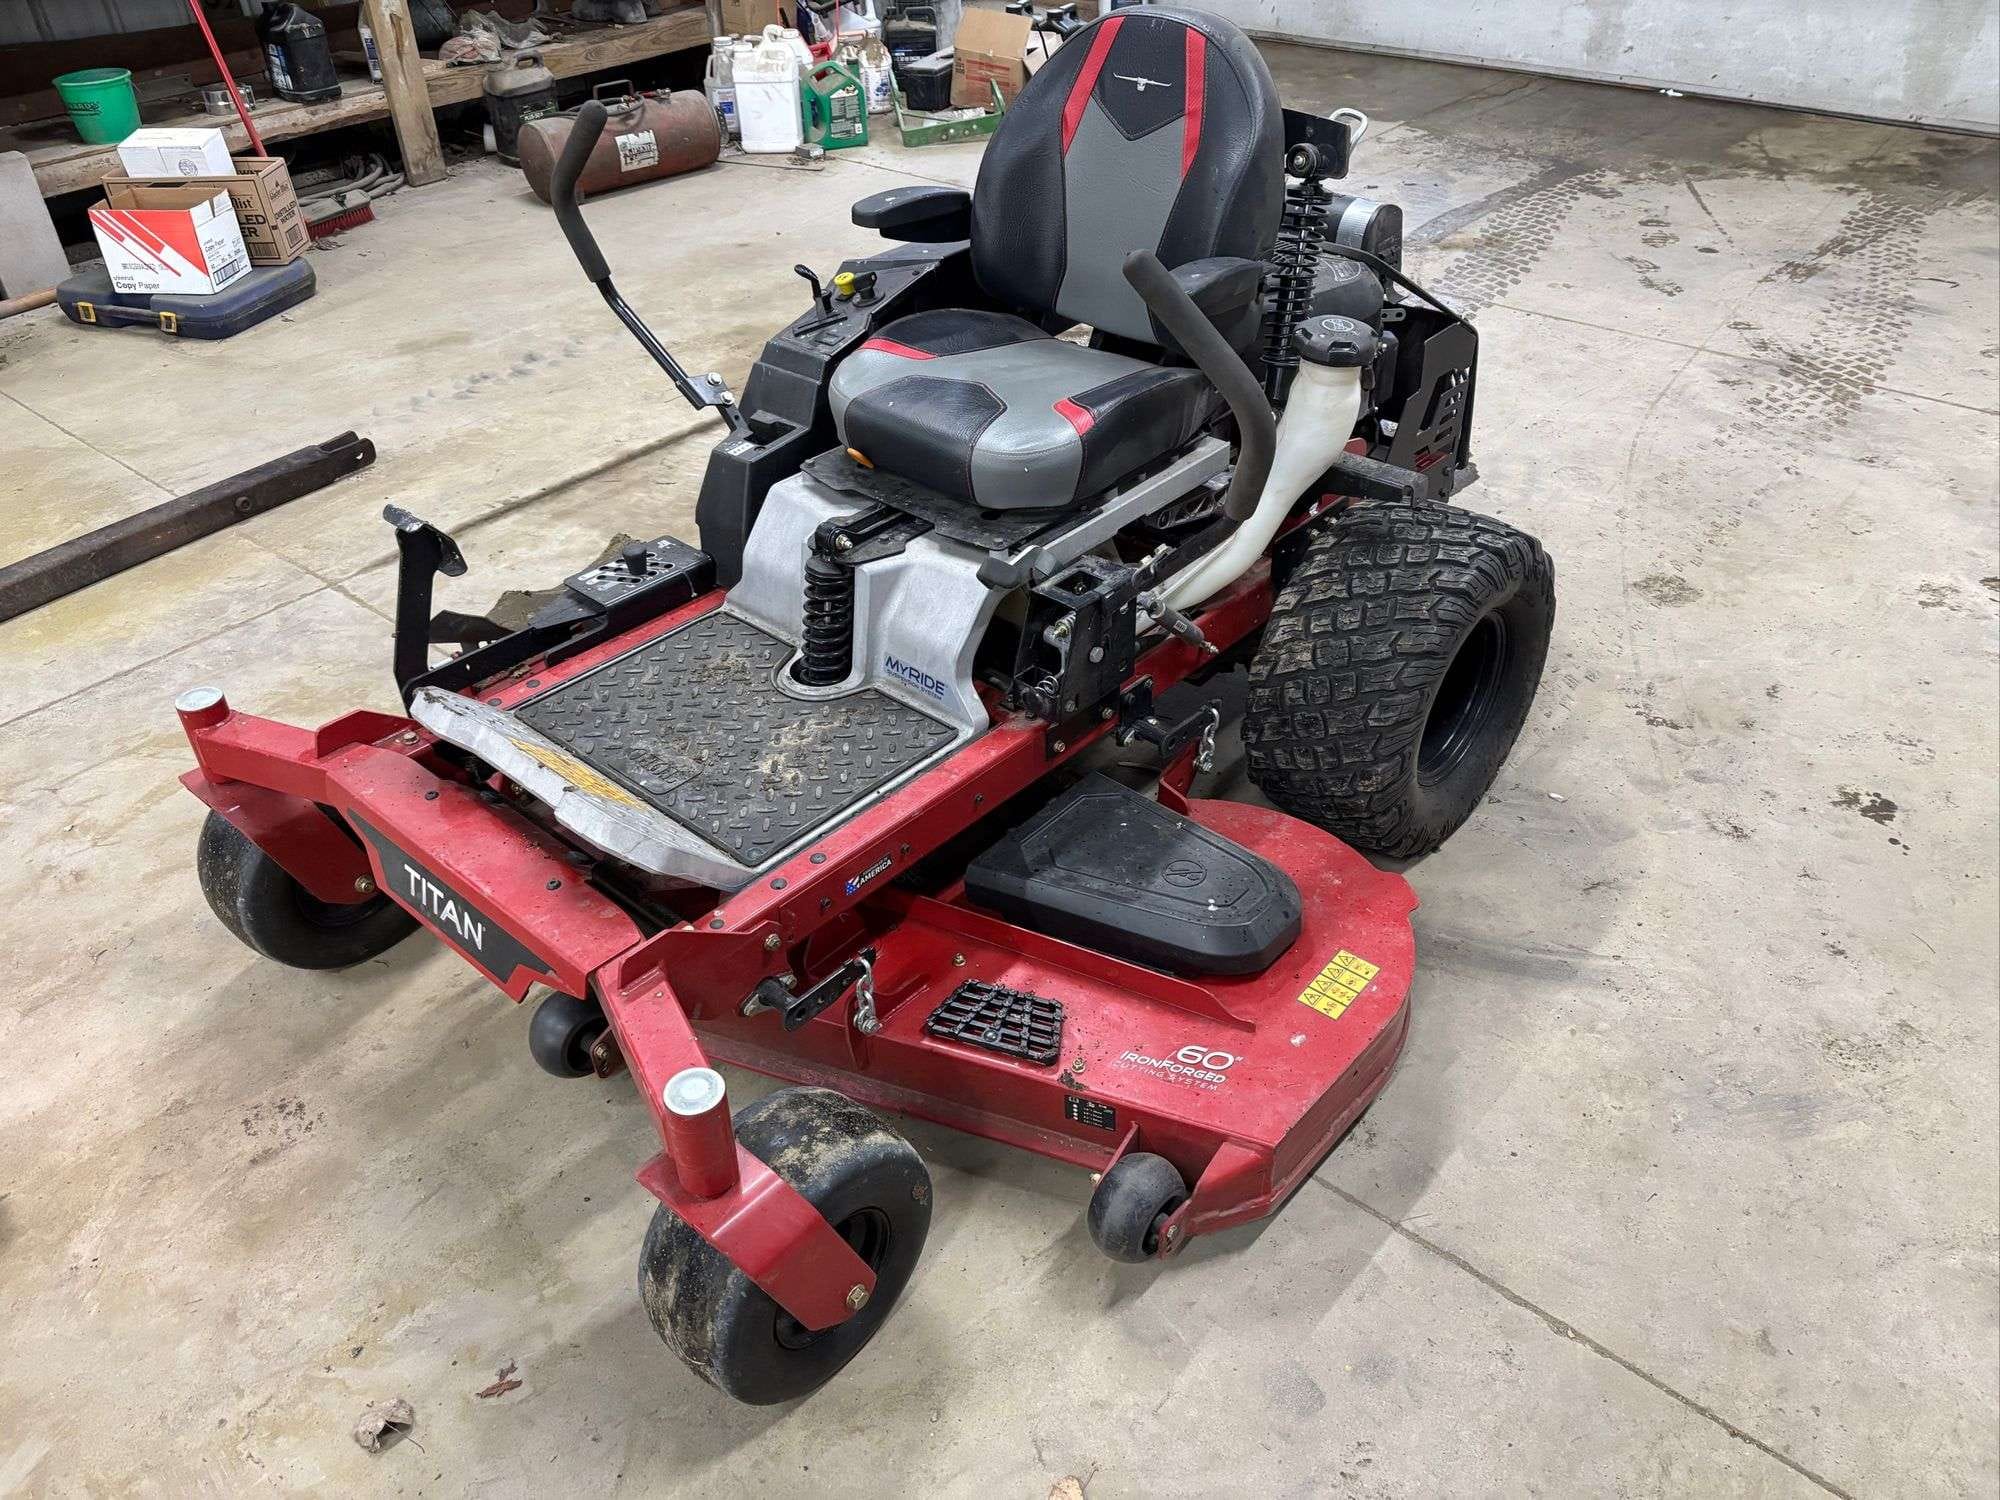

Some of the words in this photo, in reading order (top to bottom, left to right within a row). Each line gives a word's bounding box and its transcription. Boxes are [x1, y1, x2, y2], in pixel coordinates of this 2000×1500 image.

[116, 281, 137, 290] Copy
[138, 281, 160, 290] Paper
[860, 859, 892, 885] AMERICA
[404, 863, 483, 951] TITAN
[1112, 1060, 1165, 1079] CUTTING
[1167, 1074, 1218, 1092] SYSTEM
